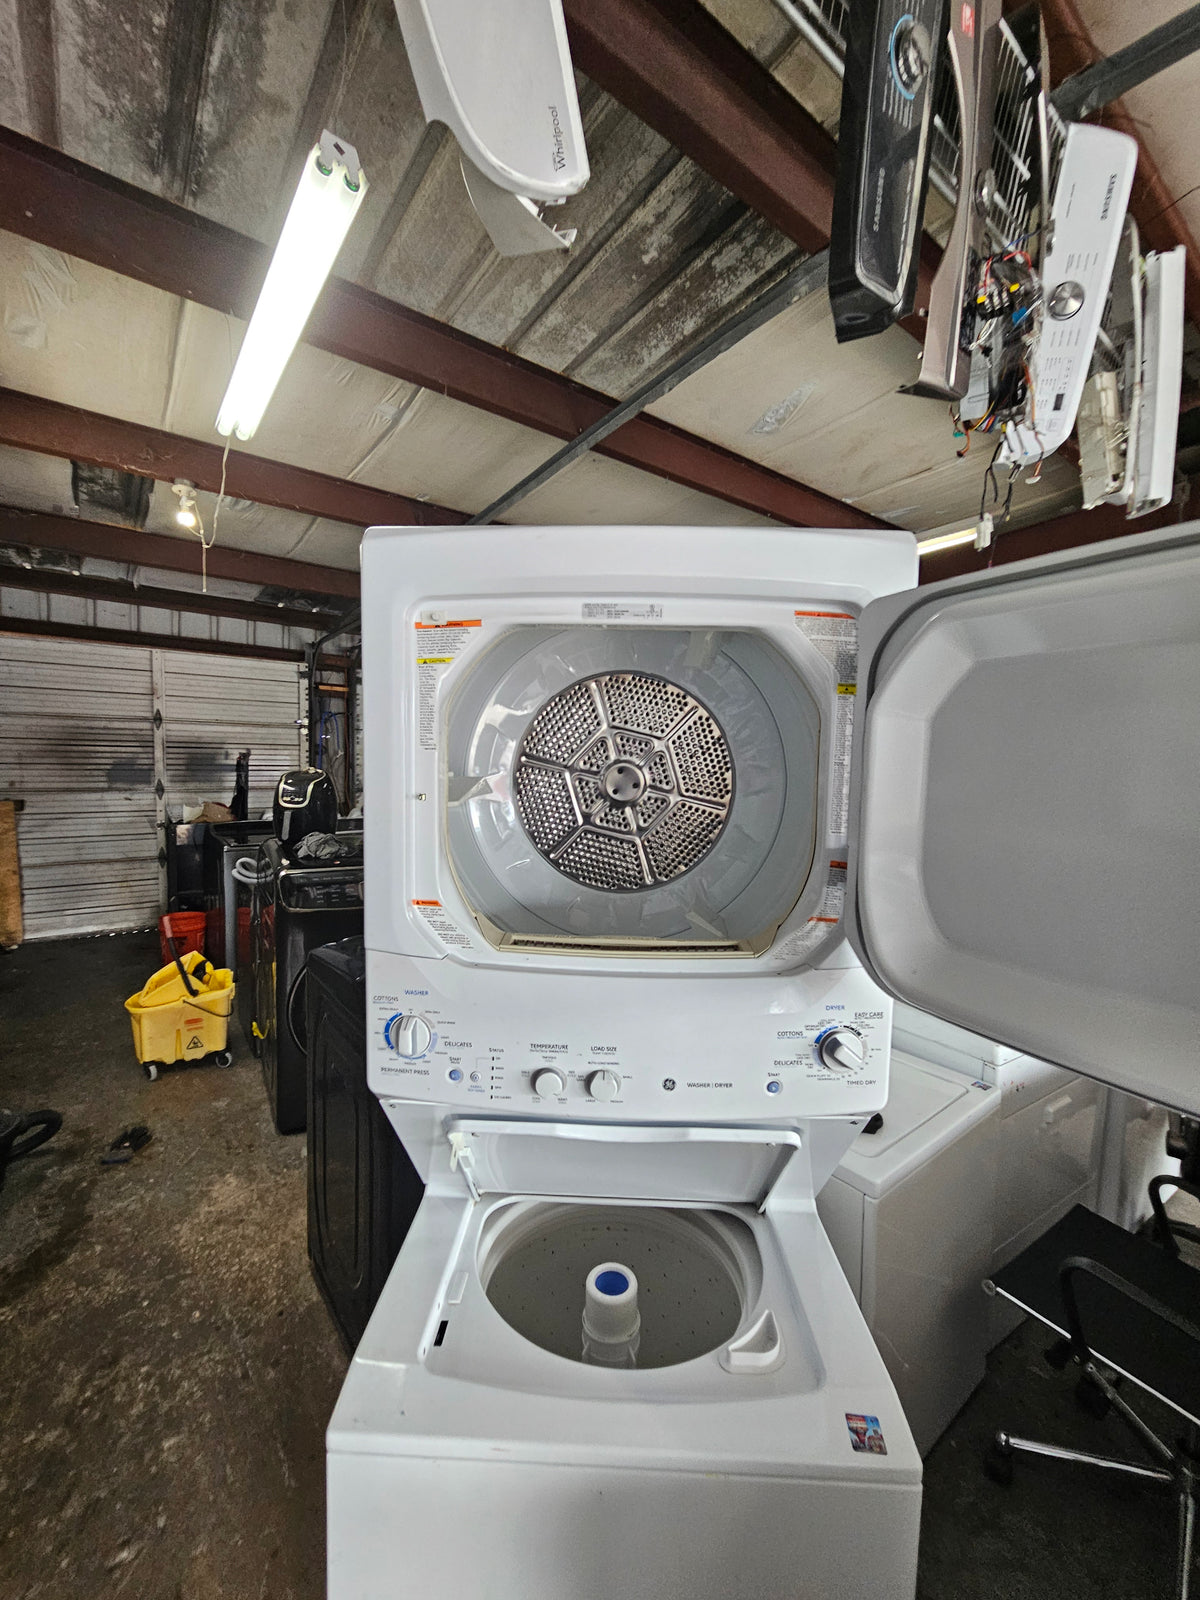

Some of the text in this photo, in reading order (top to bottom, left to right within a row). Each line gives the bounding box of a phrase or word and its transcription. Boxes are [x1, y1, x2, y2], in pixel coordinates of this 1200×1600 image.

[548, 105, 566, 170] Whirlpool
[873, 167, 885, 232] SAMSUNG
[381, 1067, 413, 1075] PERMANENT
